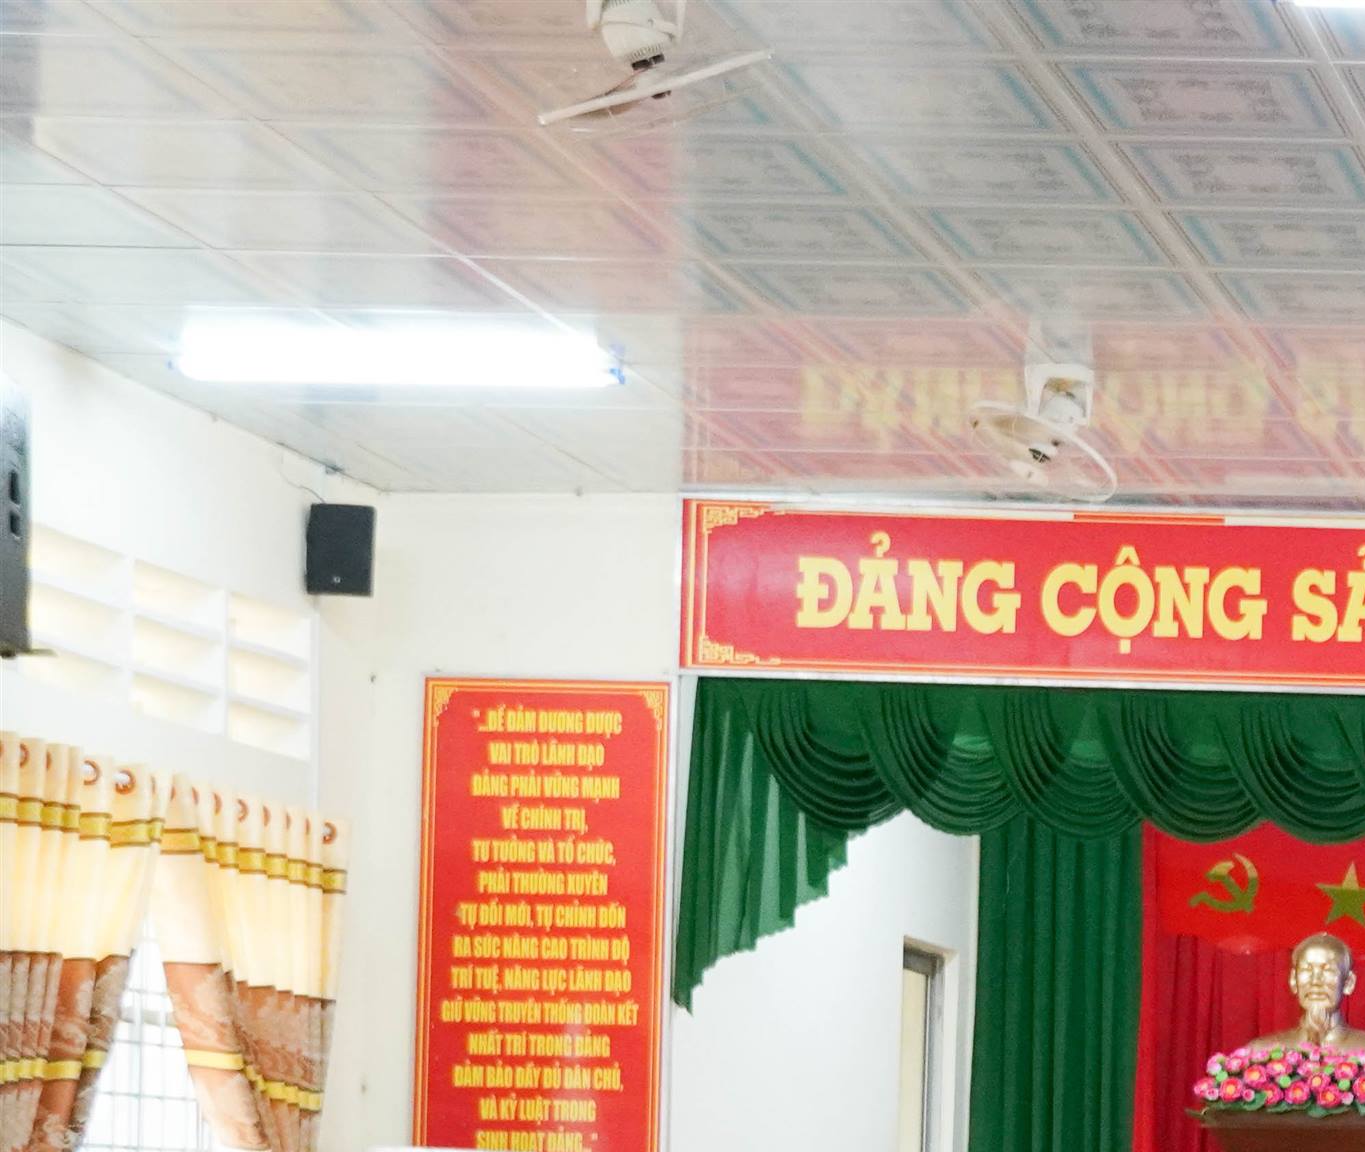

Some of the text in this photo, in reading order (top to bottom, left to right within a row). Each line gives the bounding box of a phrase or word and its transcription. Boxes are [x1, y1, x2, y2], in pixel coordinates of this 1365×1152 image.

[796, 532, 1021, 633] ĐẢNG
[1041, 545, 1267, 653] CỘNG
[489, 742, 511, 764] VAI
[472, 768, 508, 796] ĐẢNG
[479, 867, 510, 894] PHẢI
[453, 936, 471, 957] RA
[541, 937, 568, 959] CAO
[530, 1036, 572, 1056] TRONG
[554, 1100, 596, 1122] TRONG
[476, 1131, 508, 1151] SINH
